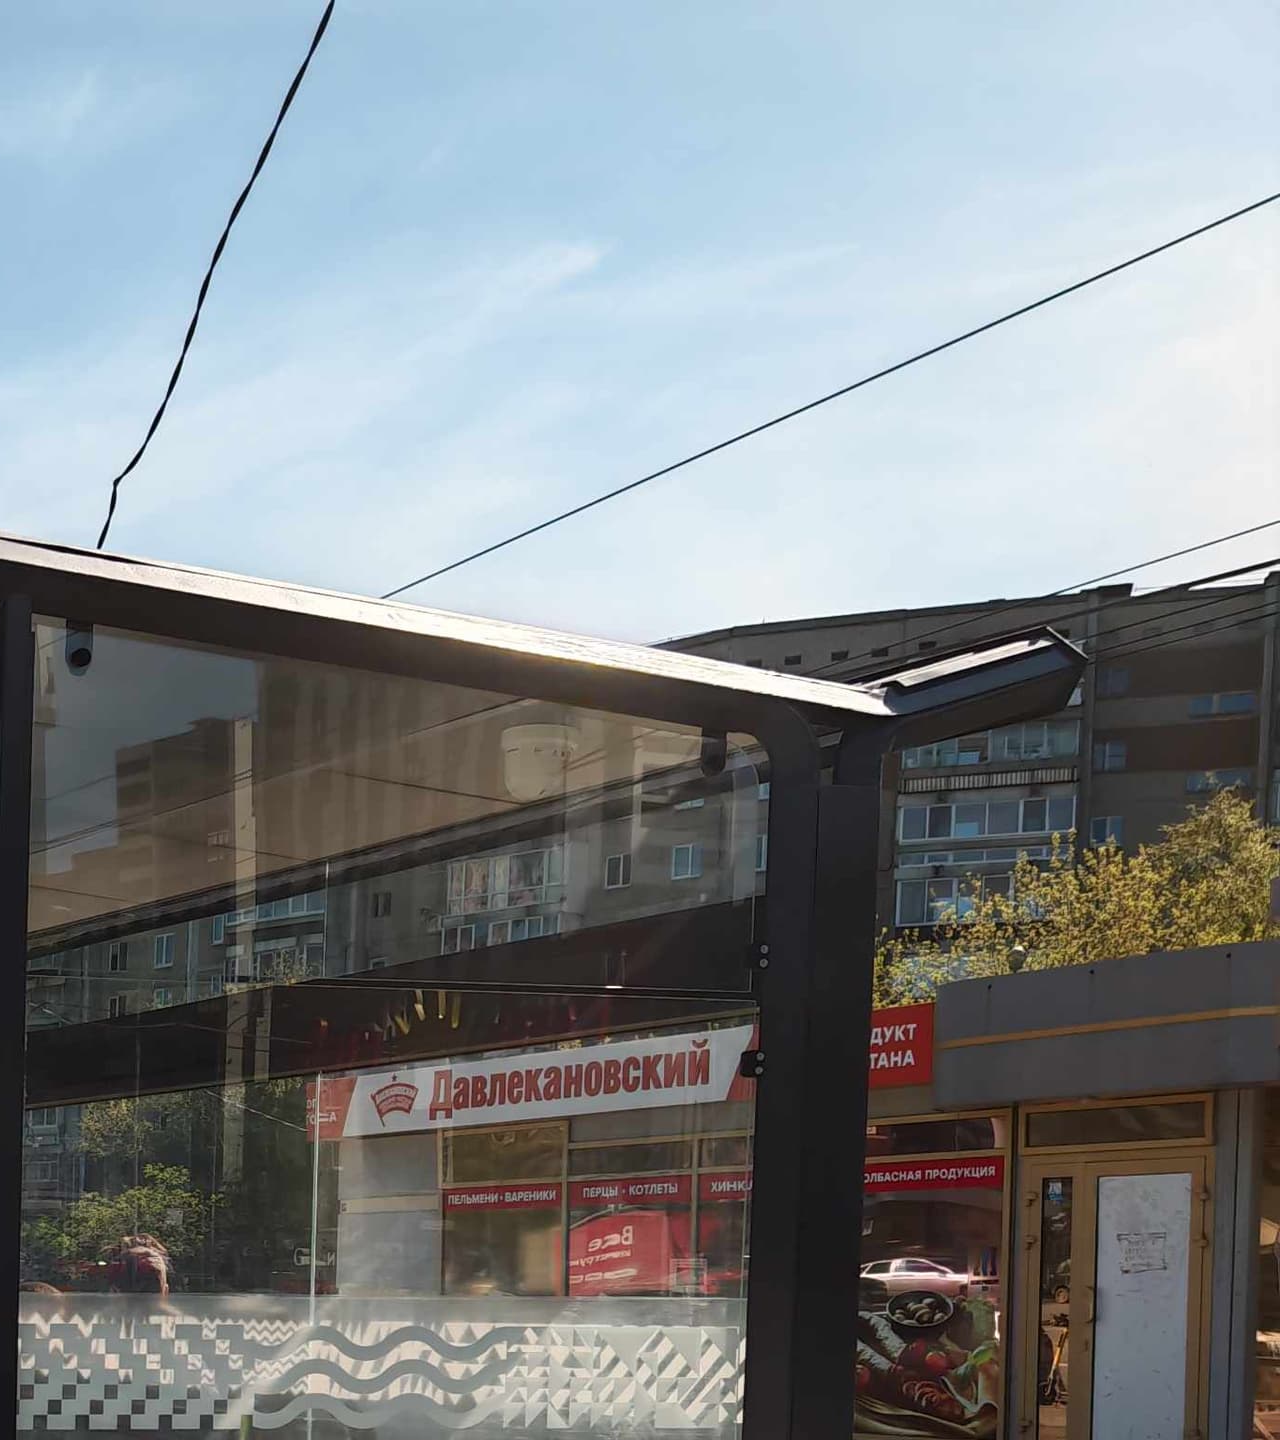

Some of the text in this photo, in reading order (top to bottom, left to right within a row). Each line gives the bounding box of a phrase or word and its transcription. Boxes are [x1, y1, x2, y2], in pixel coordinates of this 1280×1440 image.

[870, 1024, 917, 1046] ДУКТ
[869, 1049, 915, 1069] ТАНА
[429, 1038, 711, 1120] Давлекановский
[925, 1166, 996, 1180] ПРОДУКЦИЯ
[448, 1189, 556, 1205] ПЕЛЬМЕНИ ВАРЕНИКИ
[583, 1183, 678, 1198] ПЕРЦЫ КОТЛЕТЫ
